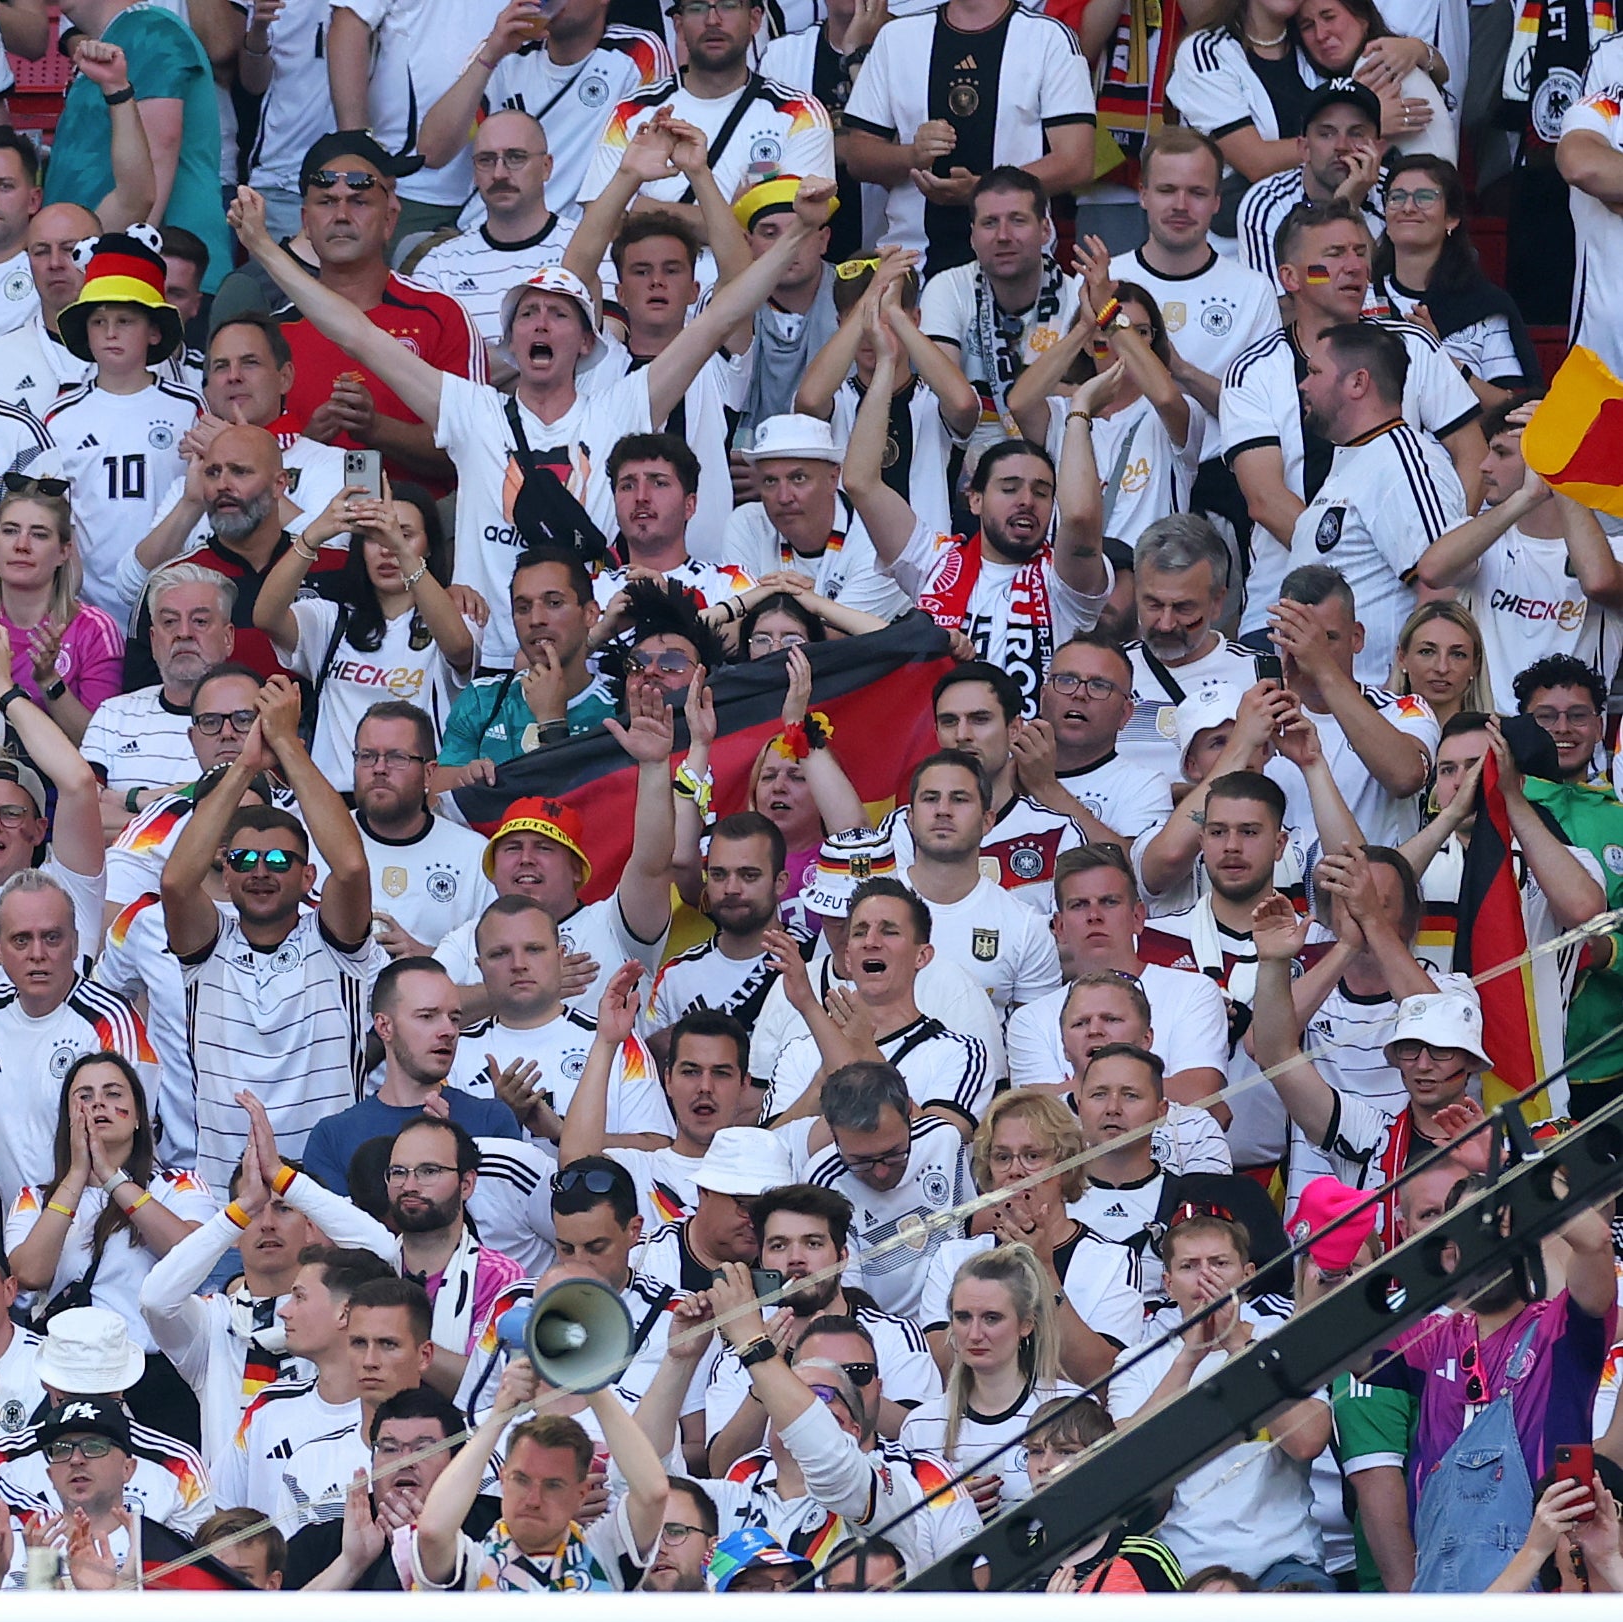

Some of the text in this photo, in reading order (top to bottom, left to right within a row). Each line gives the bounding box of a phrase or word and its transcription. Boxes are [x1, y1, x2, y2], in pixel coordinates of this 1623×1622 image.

[1547, 0, 1567, 41] FT
[103, 453, 147, 500] 10
[1489, 588, 1584, 626] CHECK24
